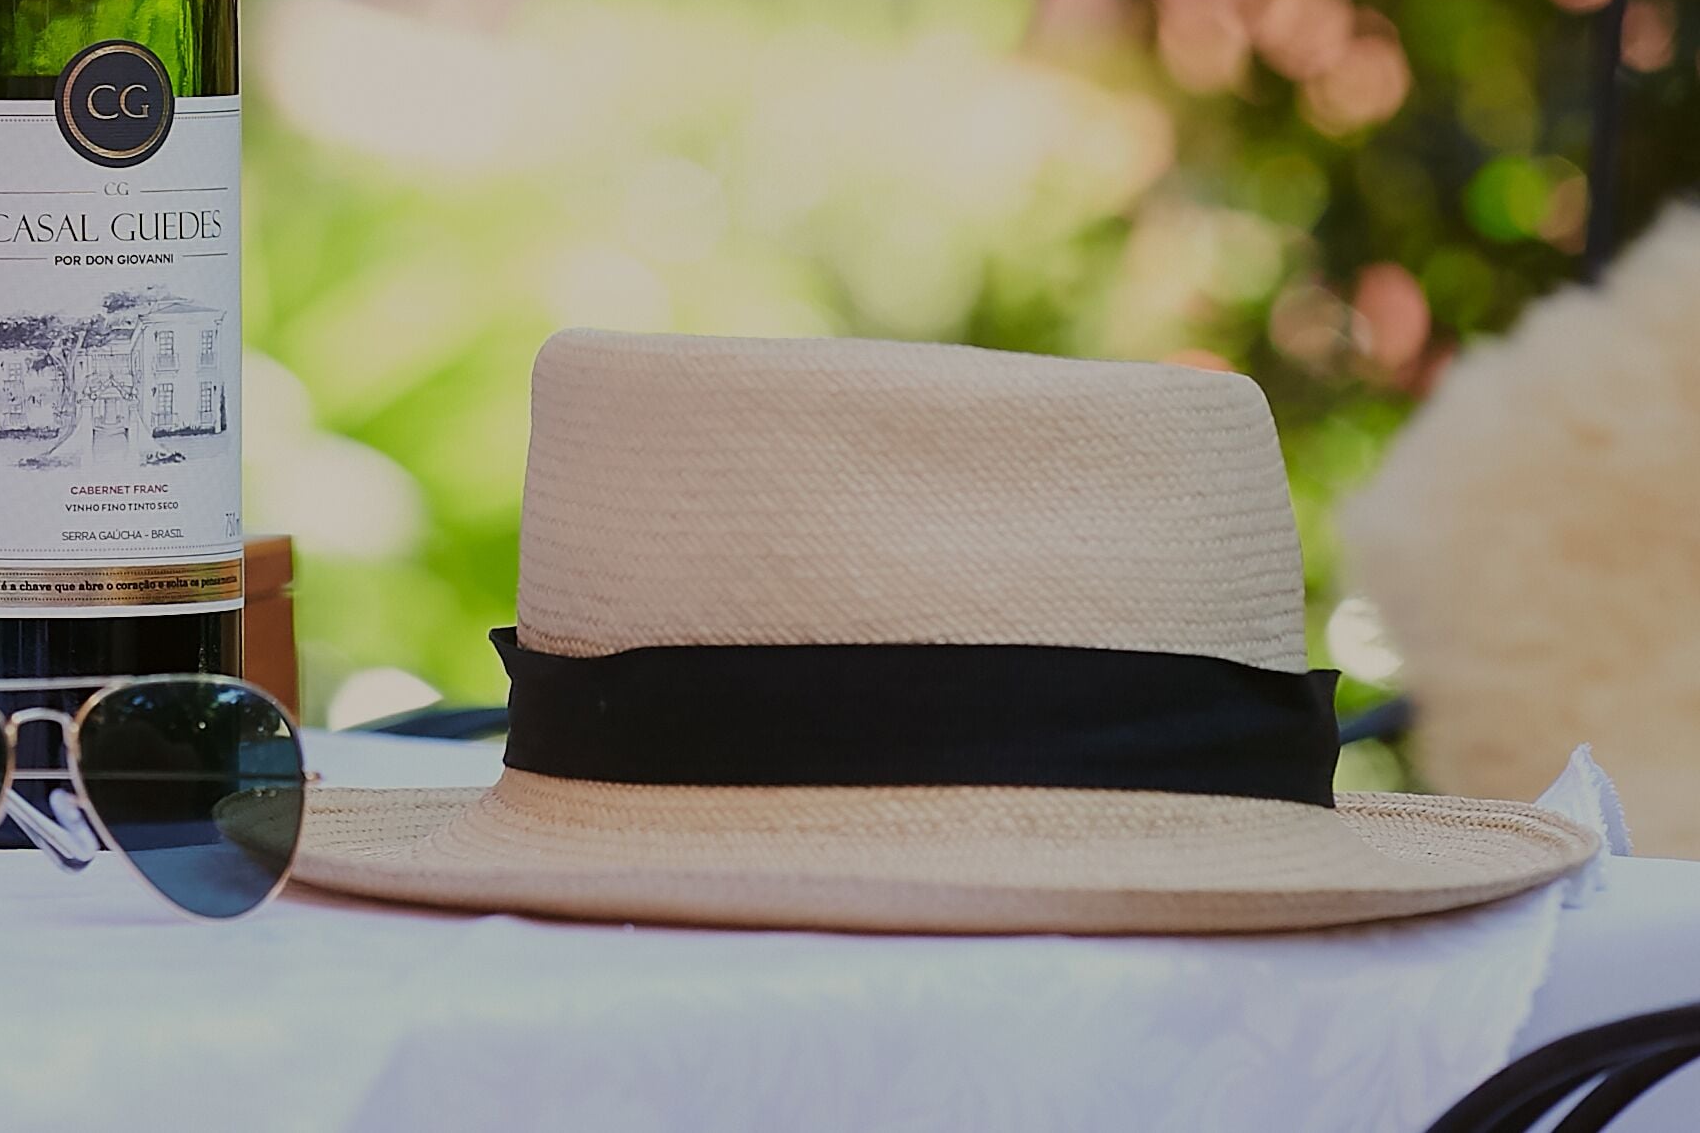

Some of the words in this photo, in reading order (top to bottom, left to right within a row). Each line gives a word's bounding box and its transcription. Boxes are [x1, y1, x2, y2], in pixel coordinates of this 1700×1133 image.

[86, 84, 149, 120] CG
[104, 181, 129, 197] CG
[110, 209, 222, 242] GUEDES
[54, 255, 82, 266] POR
[85, 255, 114, 266] DON
[117, 253, 174, 265] GIOVANNI
[70, 485, 131, 495] CABERNET
[133, 484, 169, 494] FRANC
[65, 504, 99, 512] VINHO
[101, 503, 126, 512] FINO
[128, 502, 156, 511] TINTO
[157, 501, 179, 510] SECO
[62, 531, 97, 541] SERRA
[99, 529, 142, 541] GAÚCHA
[151, 529, 184, 539] BRASIL
[1, 580, 8, 591] é
[10, 582, 17, 591] a
[19, 580, 52, 592] chave
[54, 583, 76, 594] que
[78, 580, 104, 592] abre
[106, 582, 113, 591] o
[115, 580, 156, 592] coração
[166, 577, 189, 589] solta
